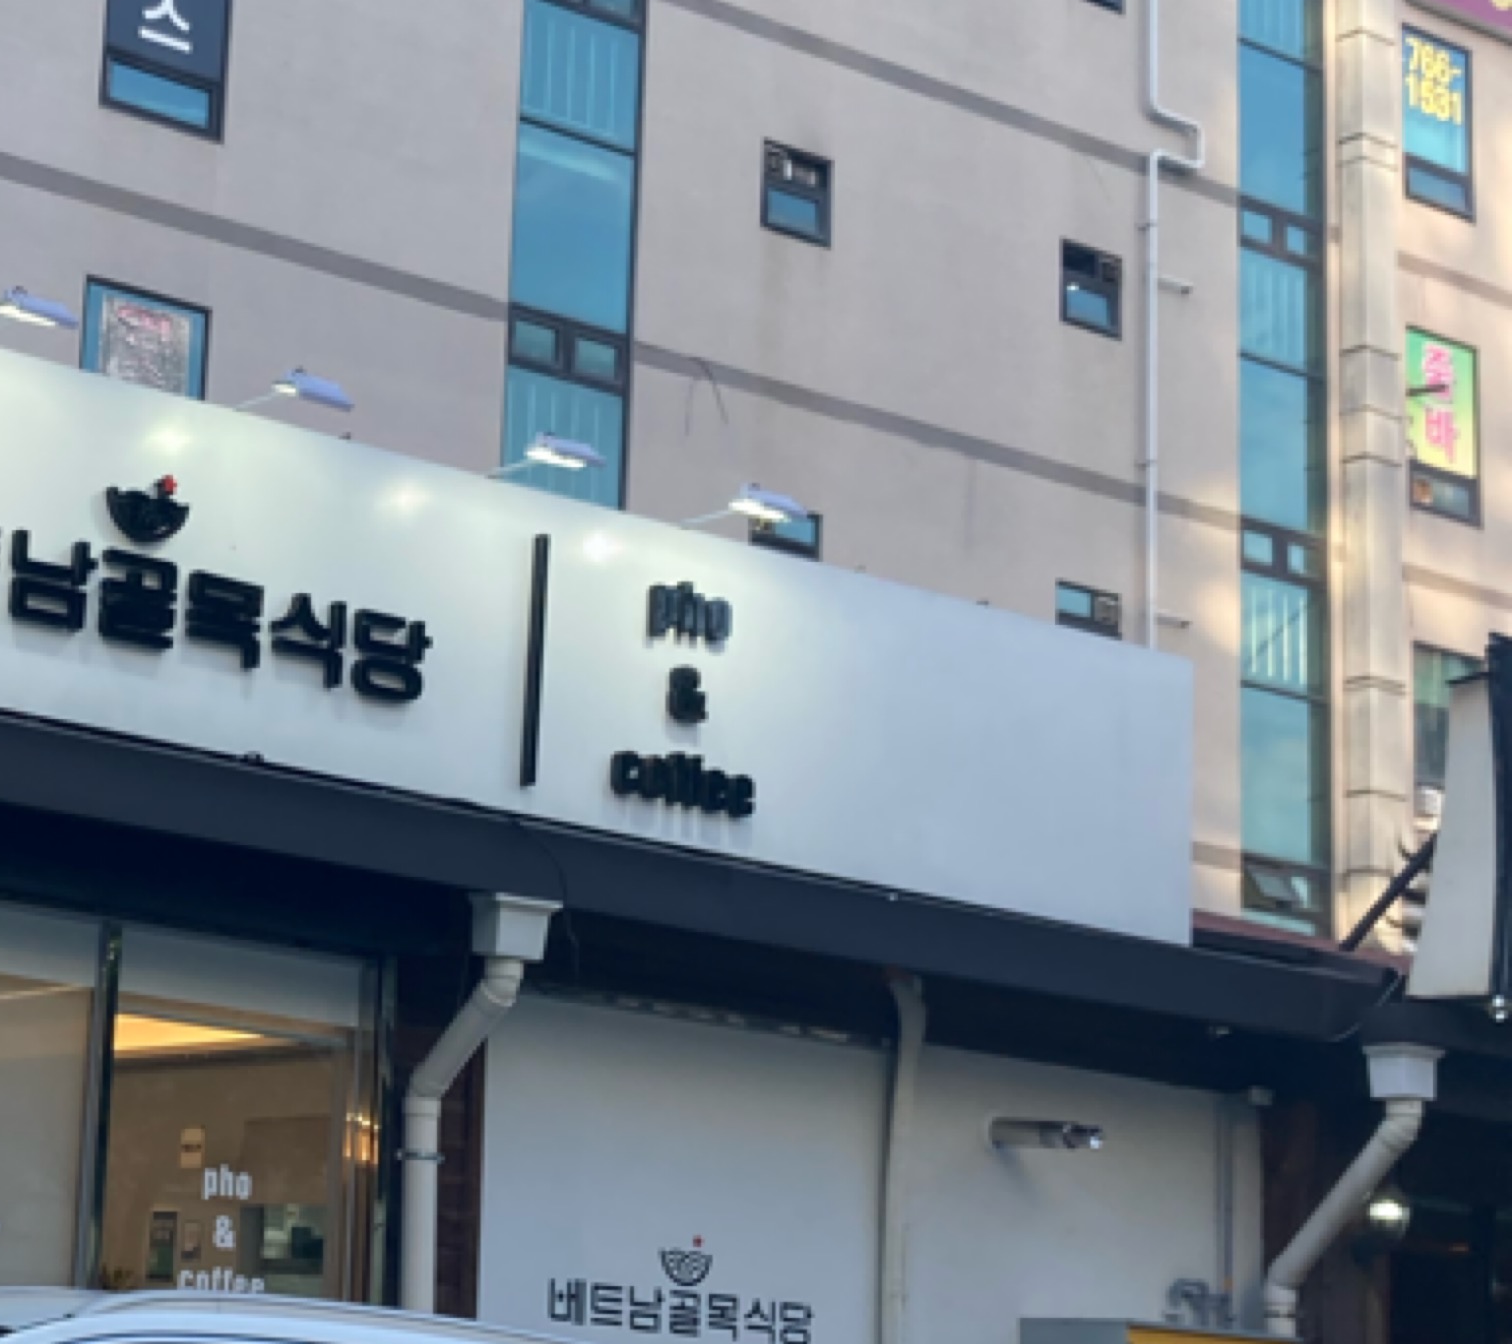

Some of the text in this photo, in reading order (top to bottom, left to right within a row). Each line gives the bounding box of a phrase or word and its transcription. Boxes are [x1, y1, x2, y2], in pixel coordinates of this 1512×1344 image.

[646, 580, 734, 643] pho
[610, 751, 756, 819] coffee
[202, 1164, 254, 1201] pho
[213, 1215, 235, 1250] &
